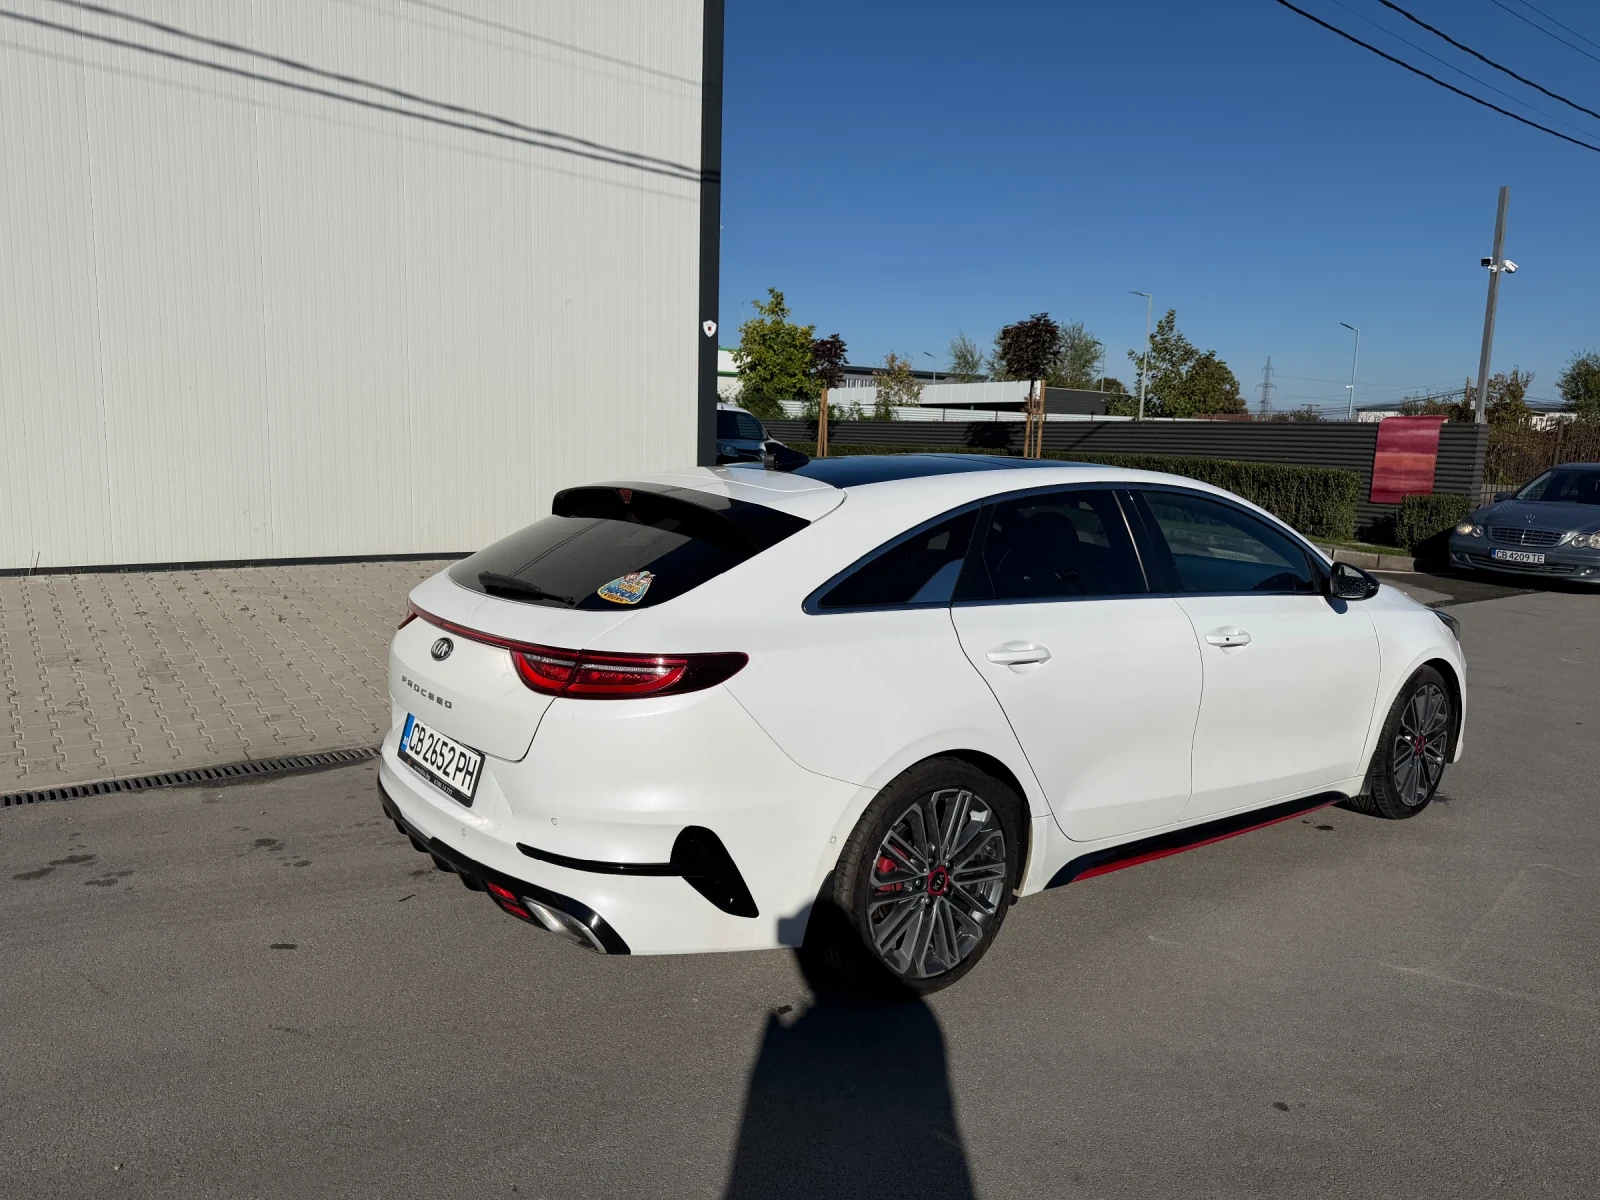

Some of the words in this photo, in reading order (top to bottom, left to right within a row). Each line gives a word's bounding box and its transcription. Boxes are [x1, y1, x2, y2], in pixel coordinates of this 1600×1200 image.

[1496, 550, 1507, 559] CB
[1509, 552, 1530, 562] 4209
[1532, 554, 1543, 563] TE
[432, 640, 449, 656] KIA
[402, 675, 452, 709] PROCEED
[409, 723, 426, 755] CB
[423, 733, 455, 778] 2652
[452, 752, 477, 790] PH
[932, 874, 945, 890] KIA
